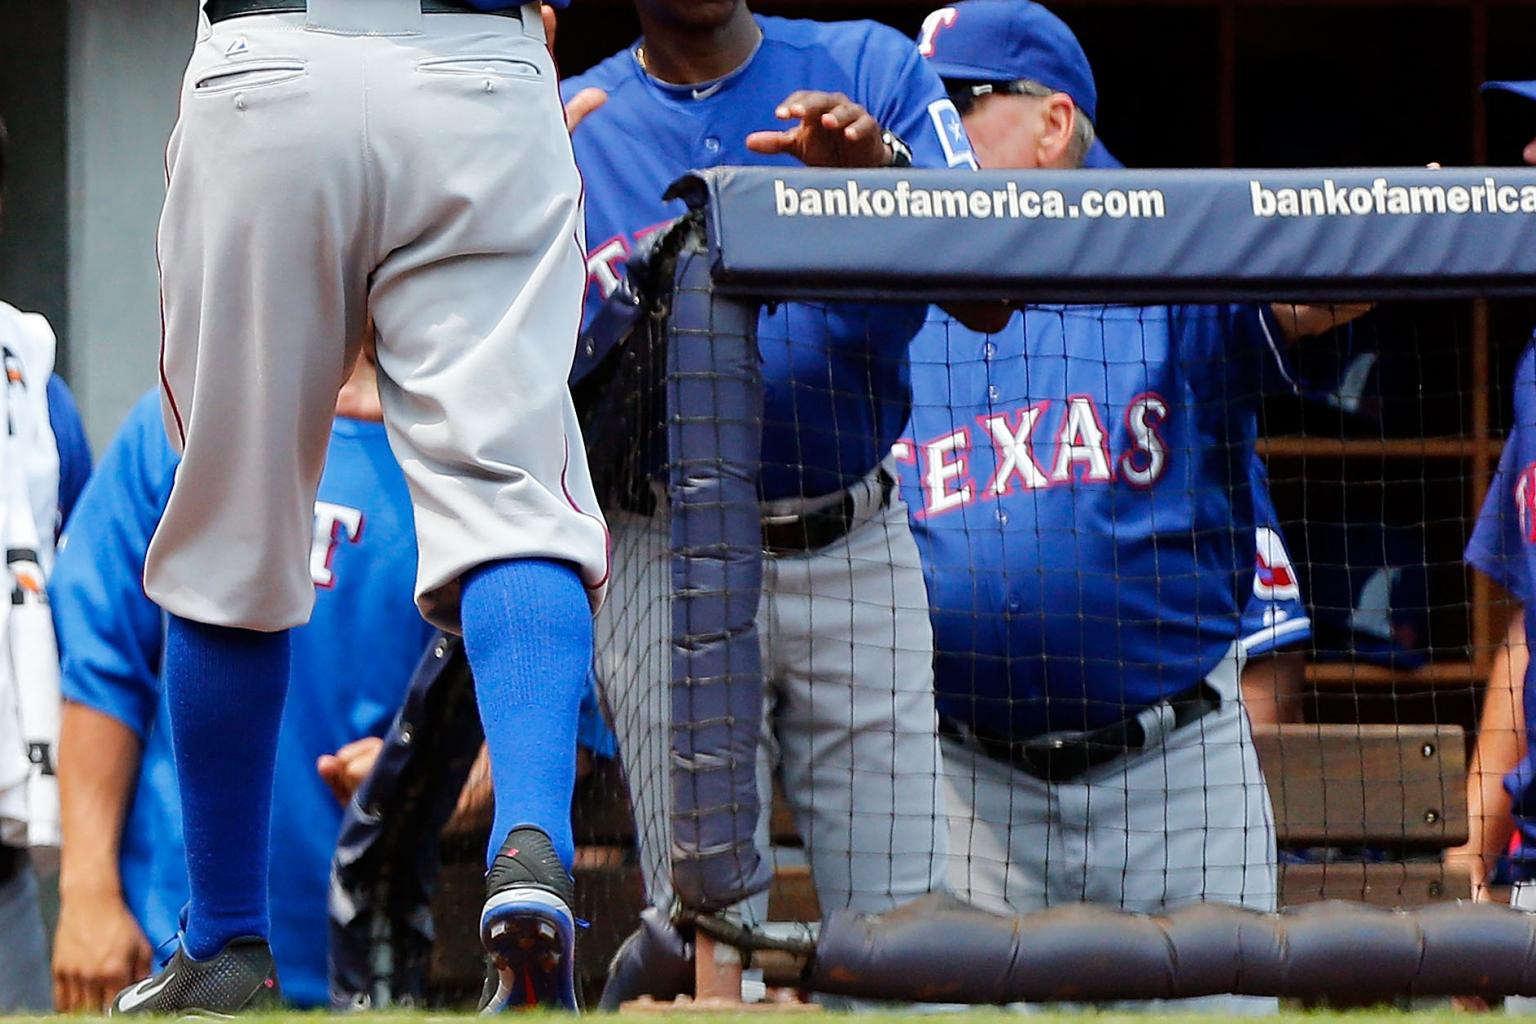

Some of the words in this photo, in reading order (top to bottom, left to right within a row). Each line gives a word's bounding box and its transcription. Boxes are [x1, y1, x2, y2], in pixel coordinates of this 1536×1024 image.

[918, 7, 961, 59] T
[774, 179, 1165, 219] bankofamerica.com
[891, 391, 1169, 521] EXAS
